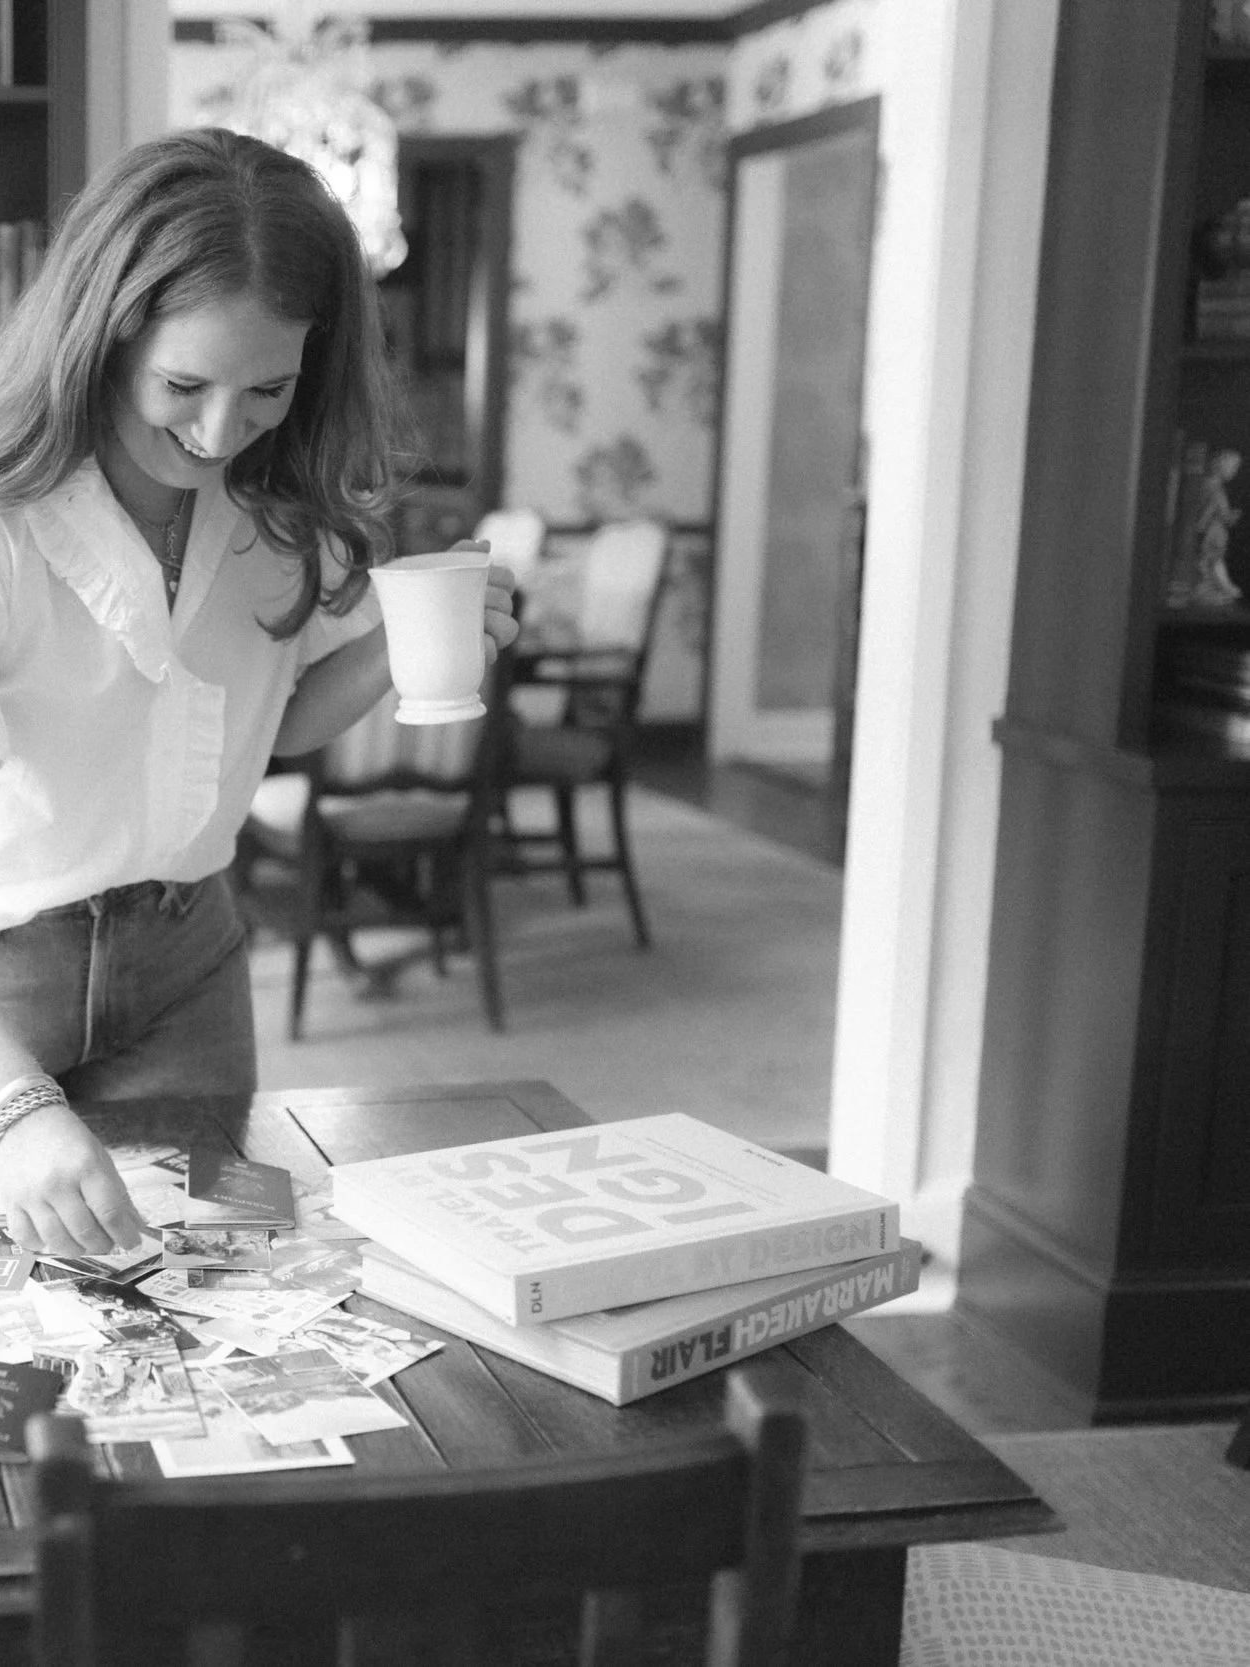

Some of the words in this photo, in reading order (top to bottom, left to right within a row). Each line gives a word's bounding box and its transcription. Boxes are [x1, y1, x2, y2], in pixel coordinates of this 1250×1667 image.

[433, 1151, 655, 1244] DES
[523, 1135, 757, 1227] IGN
[420, 1191, 549, 1253] TRAVEL
[750, 1218, 872, 1268] DESIGN
[530, 1281, 543, 1314] DLN
[733, 1263, 894, 1351] MARRAKECH
[651, 1324, 732, 1382] FLAIR
